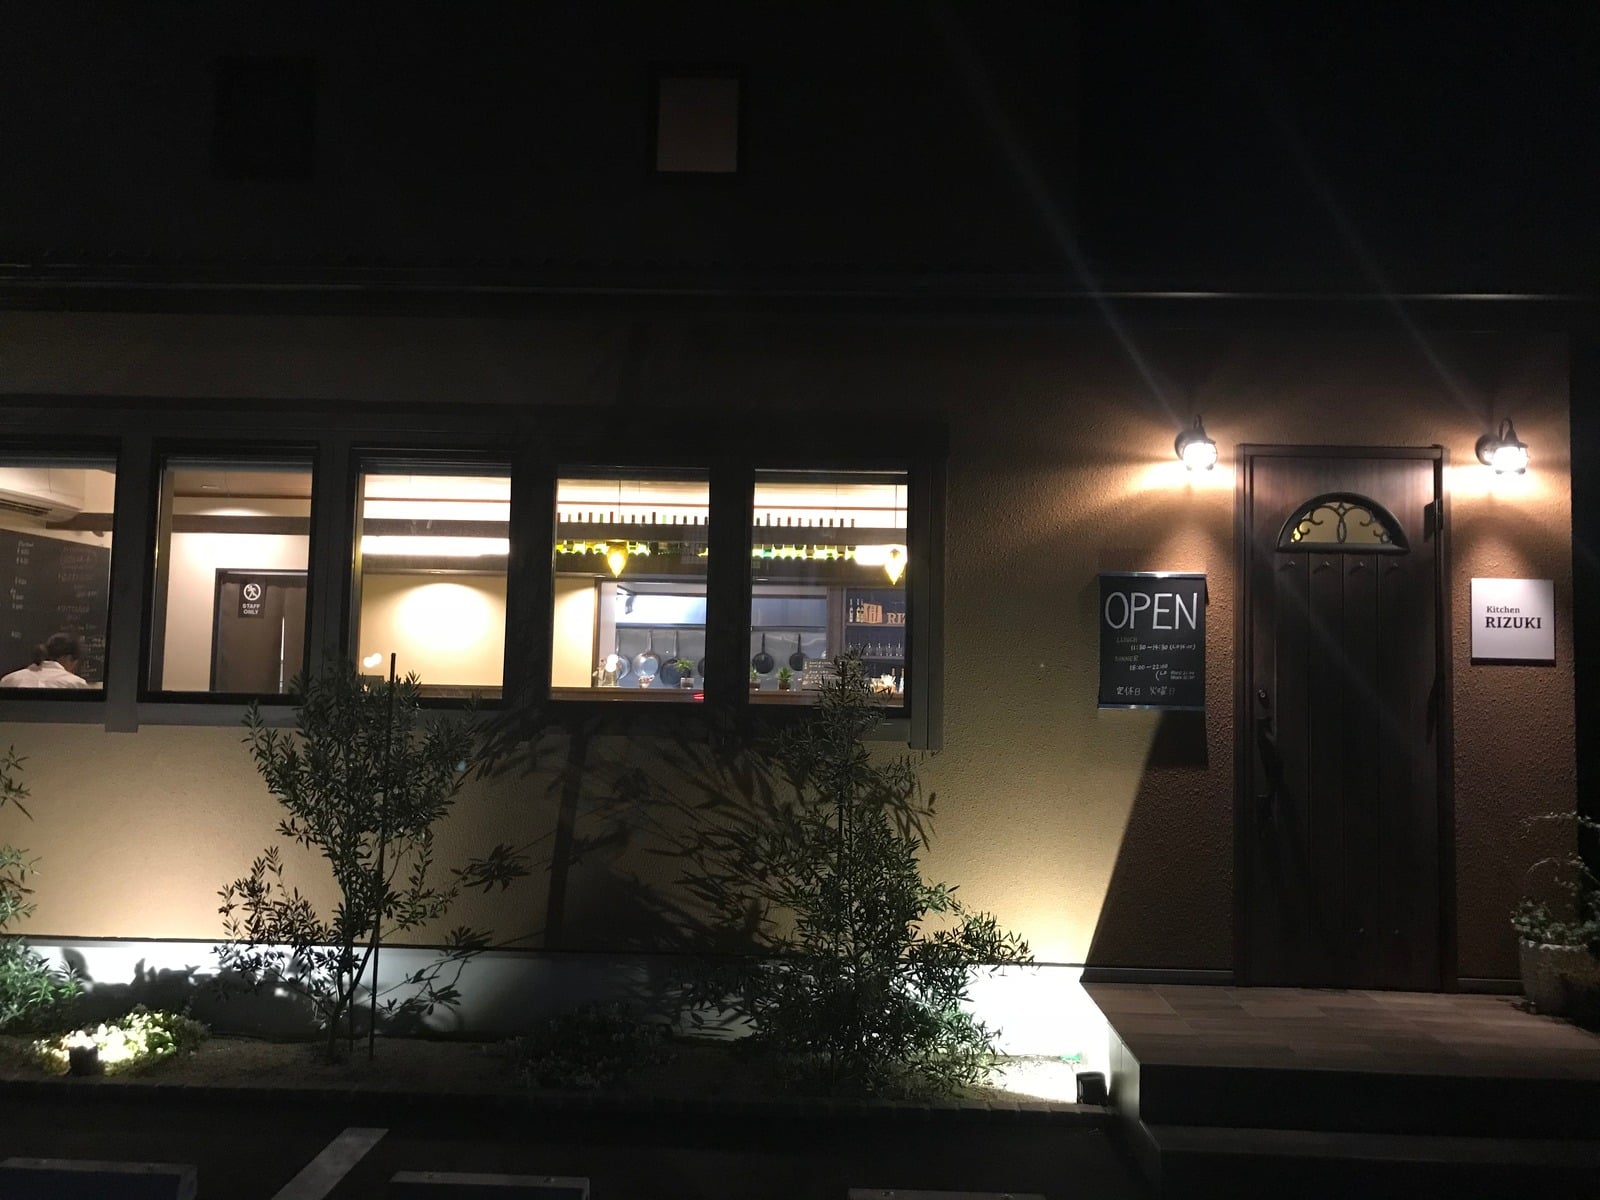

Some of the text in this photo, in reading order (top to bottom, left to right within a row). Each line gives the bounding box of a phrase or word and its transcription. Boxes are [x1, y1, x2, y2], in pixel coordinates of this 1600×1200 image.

[1105, 592, 1198, 630] OPEN
[1486, 606, 1520, 614] Kitchen
[1485, 616, 1542, 629] RIZUKI
